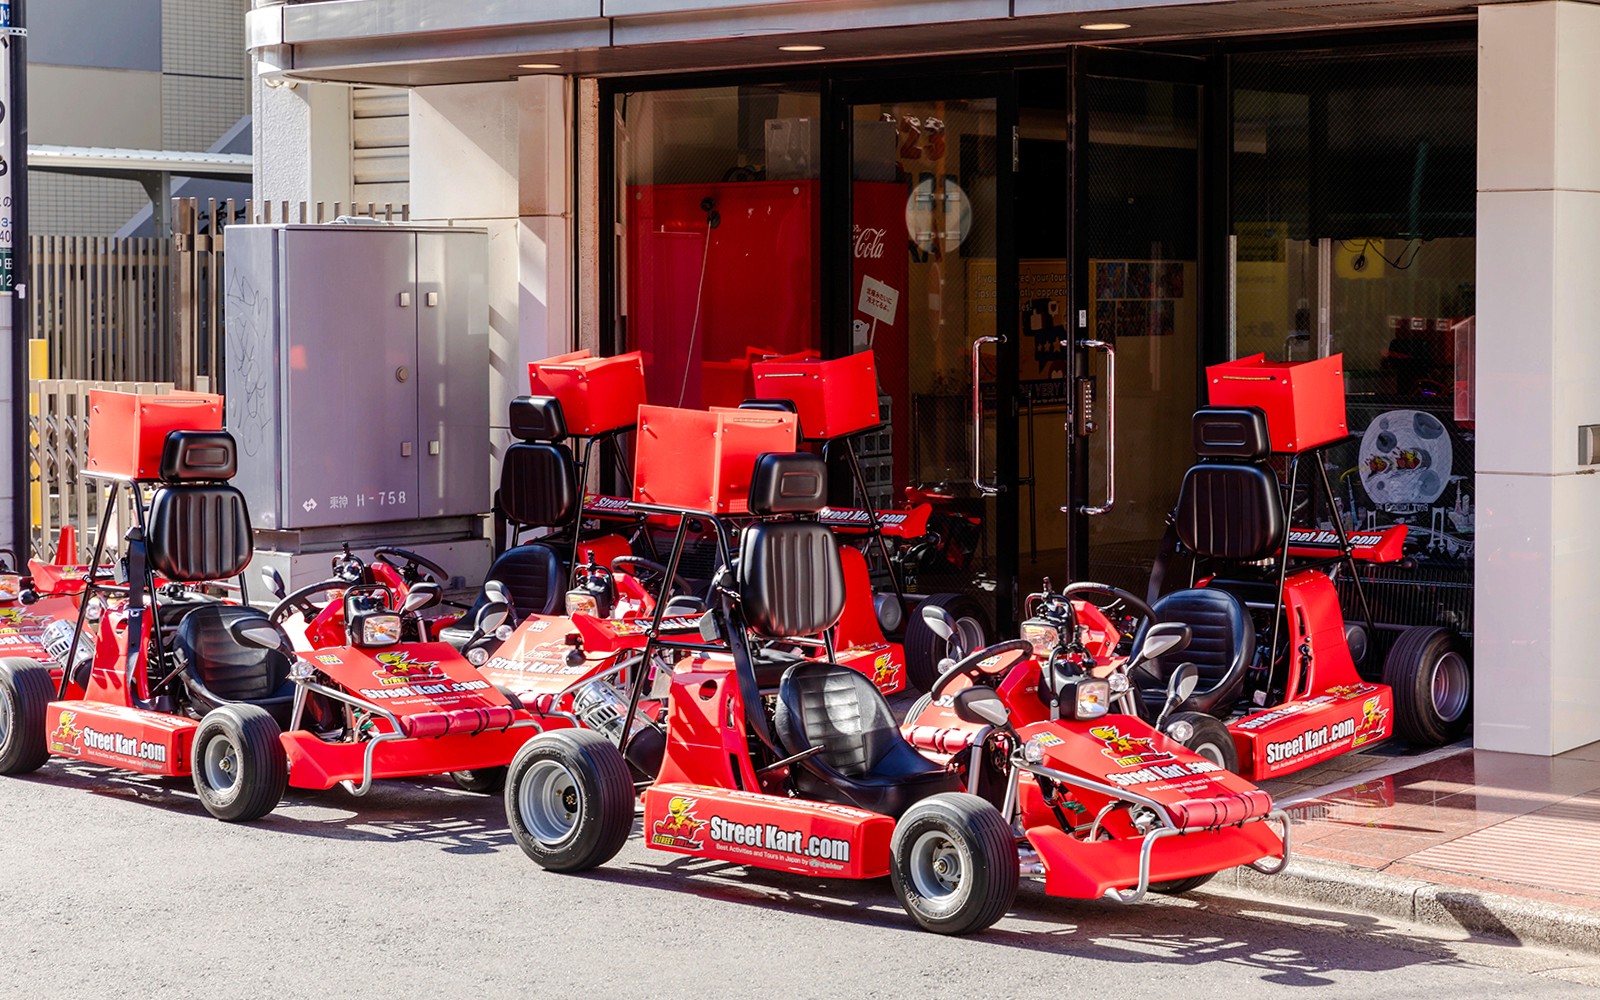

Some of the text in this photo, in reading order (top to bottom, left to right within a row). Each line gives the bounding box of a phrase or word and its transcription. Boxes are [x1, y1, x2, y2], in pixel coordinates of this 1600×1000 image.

[360, 686, 414, 700] Street
[83, 725, 114, 753] Street
[115, 732, 138, 757] Kart
[1266, 733, 1304, 765] Street
[1304, 726, 1329, 752] Kart
[1106, 768, 1162, 787] Street
[711, 814, 762, 848] Street
[764, 824, 803, 854] Kart
[716, 843, 729, 852] Best
[729, 845, 753, 855] Activities
[764, 851, 779, 860] Tours
[785, 856, 801, 865] Japan
